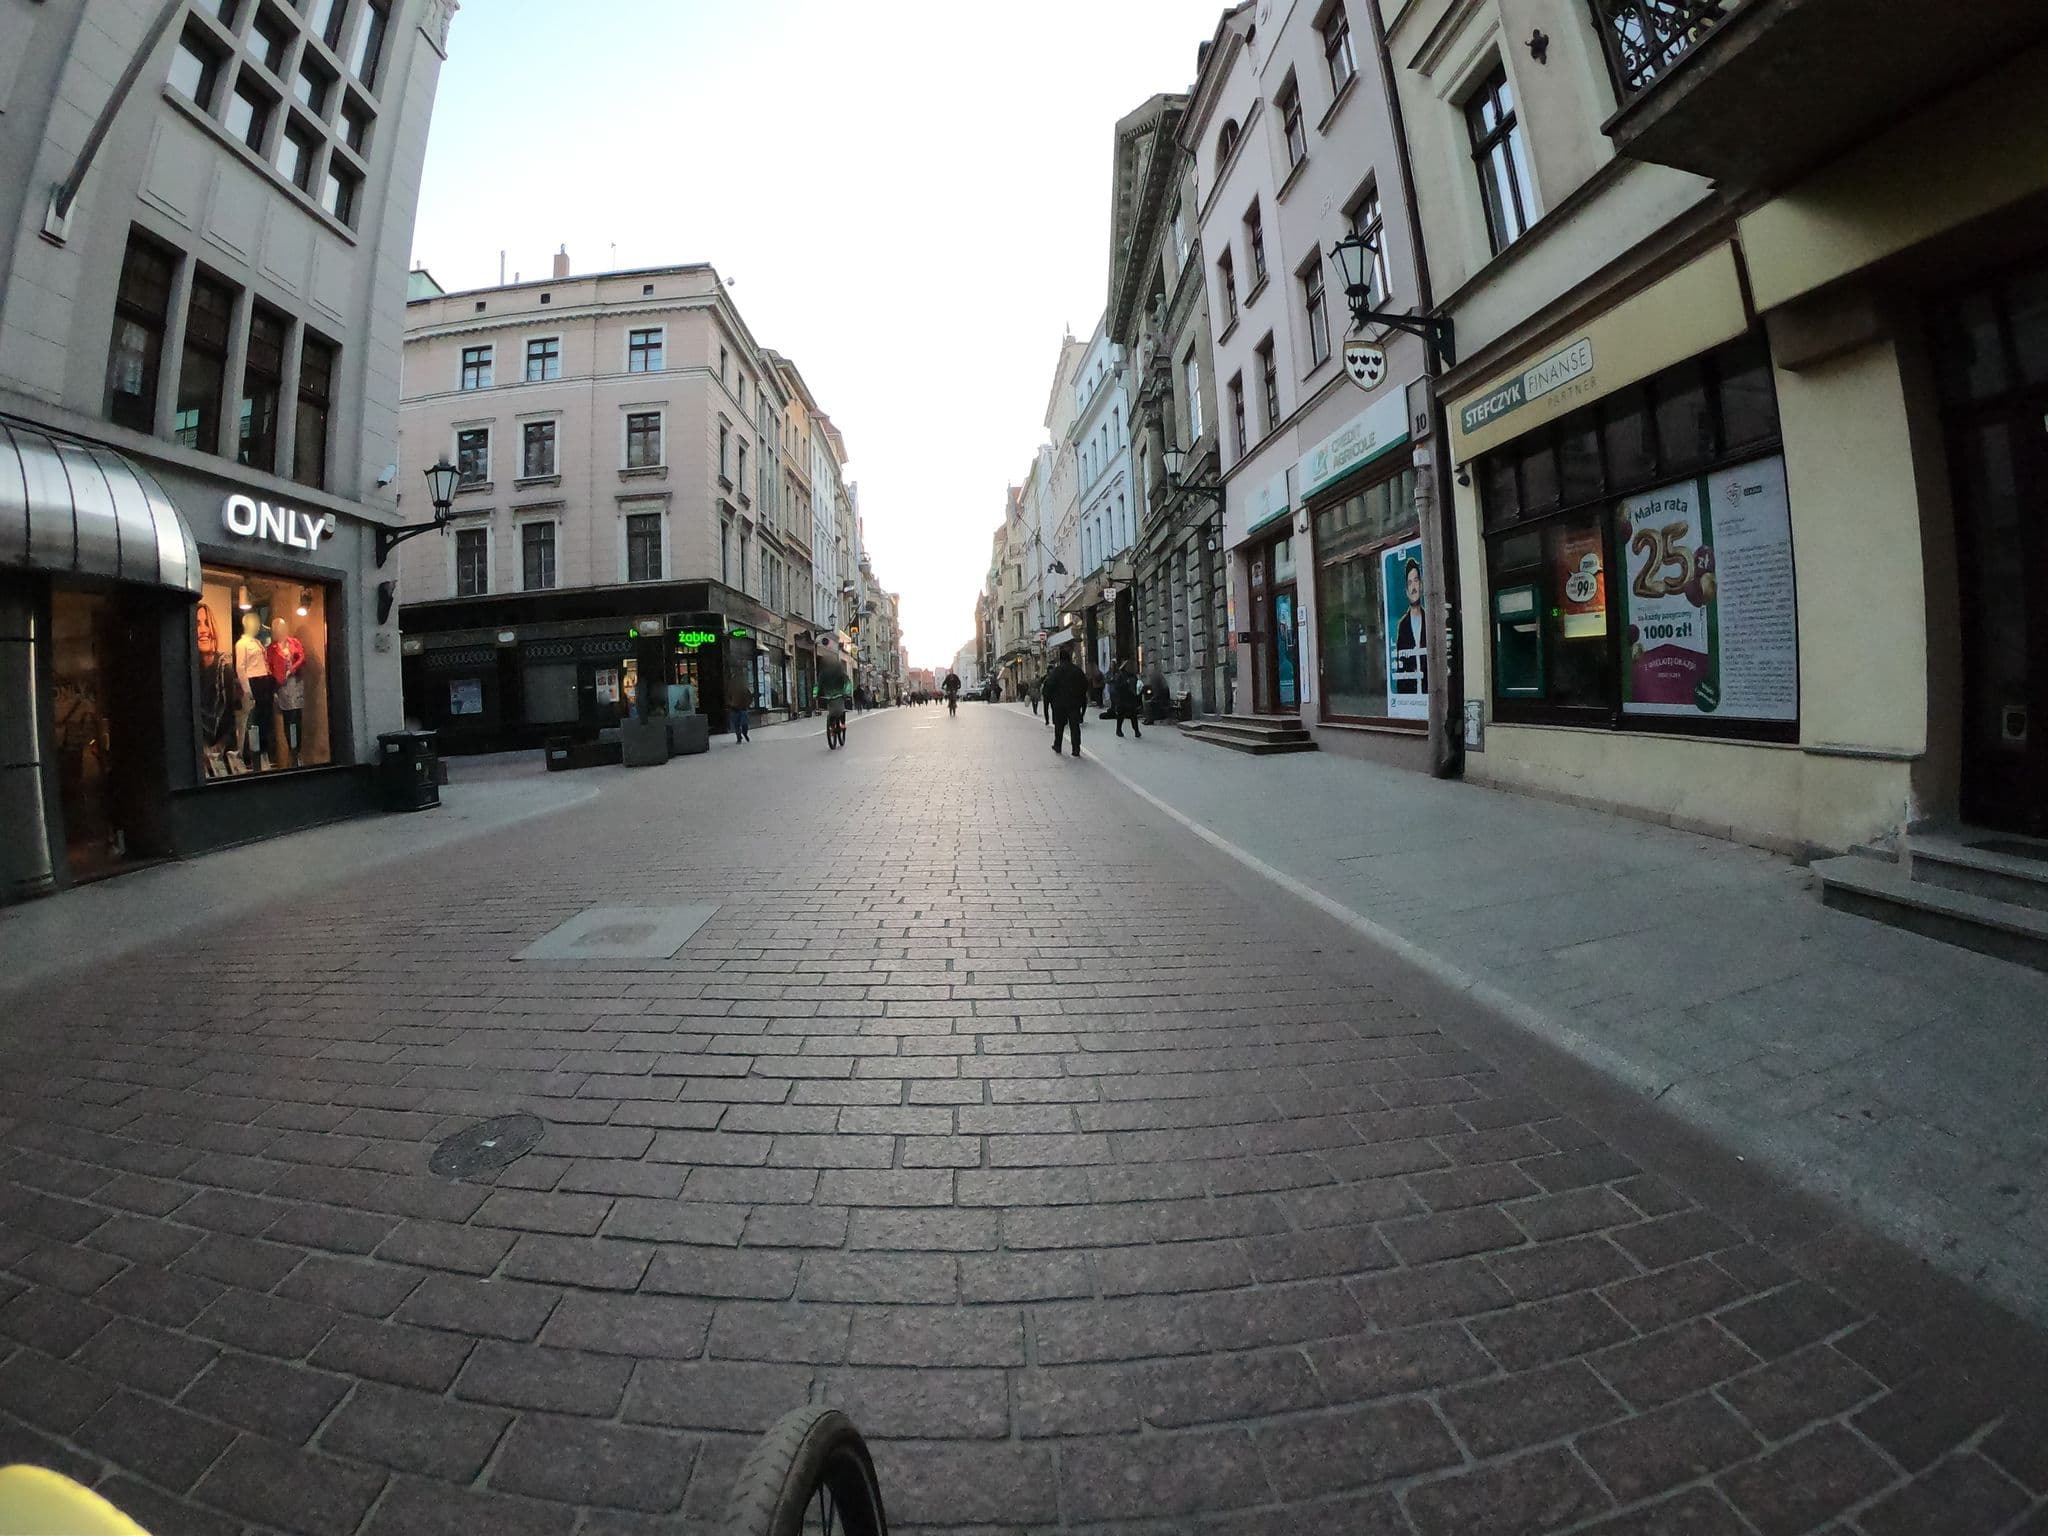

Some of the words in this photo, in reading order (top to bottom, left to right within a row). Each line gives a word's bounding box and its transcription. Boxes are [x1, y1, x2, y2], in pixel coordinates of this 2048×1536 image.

[1465, 384, 1521, 428] STEFCZYK
[1528, 347, 1586, 393] FINANSE
[1547, 376, 1597, 408] PARTNER
[1416, 413, 1427, 434] 10
[222, 494, 326, 550] ONLY
[1634, 502, 1661, 523] Mała
[1664, 498, 1688, 513] rata
[1632, 522, 1695, 598] 25
[1698, 552, 1710, 569] zł
[1577, 580, 1589, 598] 99
[679, 630, 716, 643] żabka
[1643, 623, 1674, 639] 1000
[1675, 621, 1692, 638] zł!
